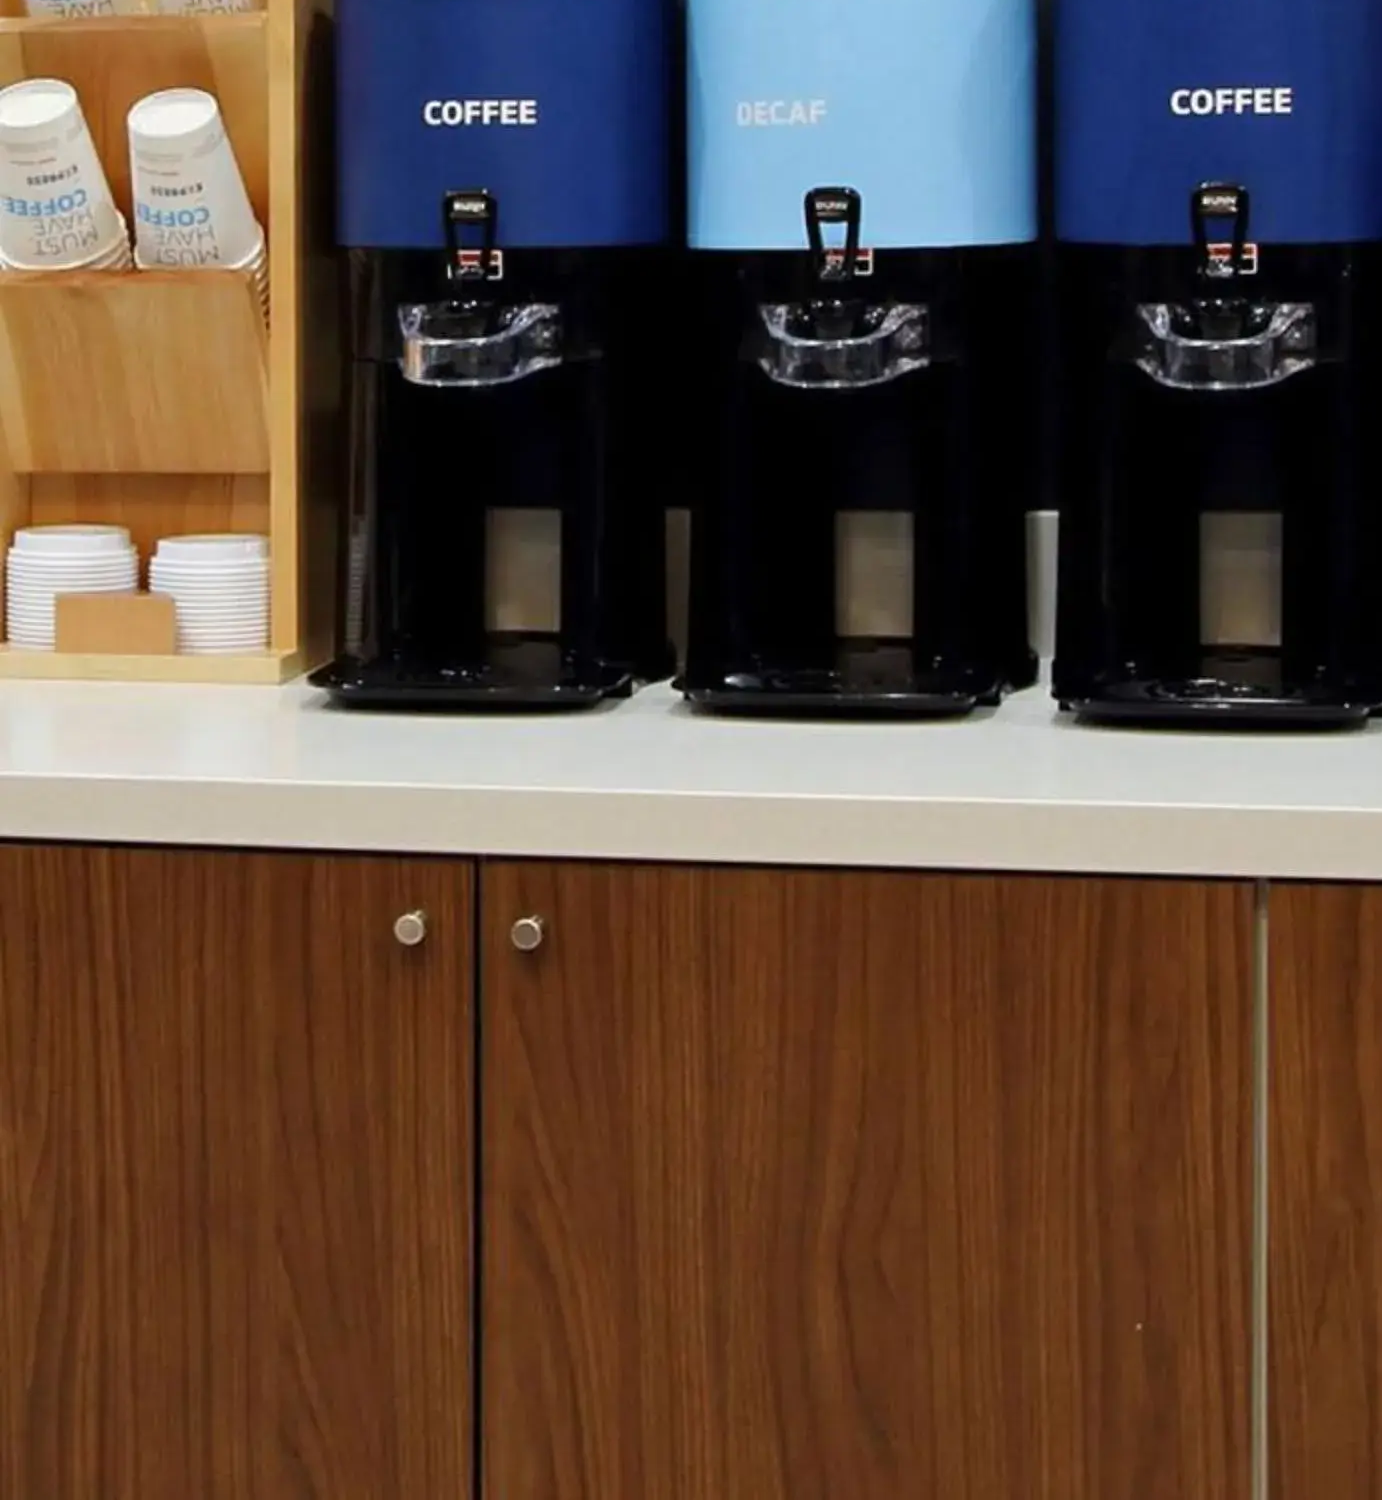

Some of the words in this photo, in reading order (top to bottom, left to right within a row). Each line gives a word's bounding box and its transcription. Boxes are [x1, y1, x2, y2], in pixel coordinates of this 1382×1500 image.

[423, 99, 538, 126] COFFEE
[736, 100, 828, 126] DECAF
[1169, 87, 1292, 115] COFFEE
